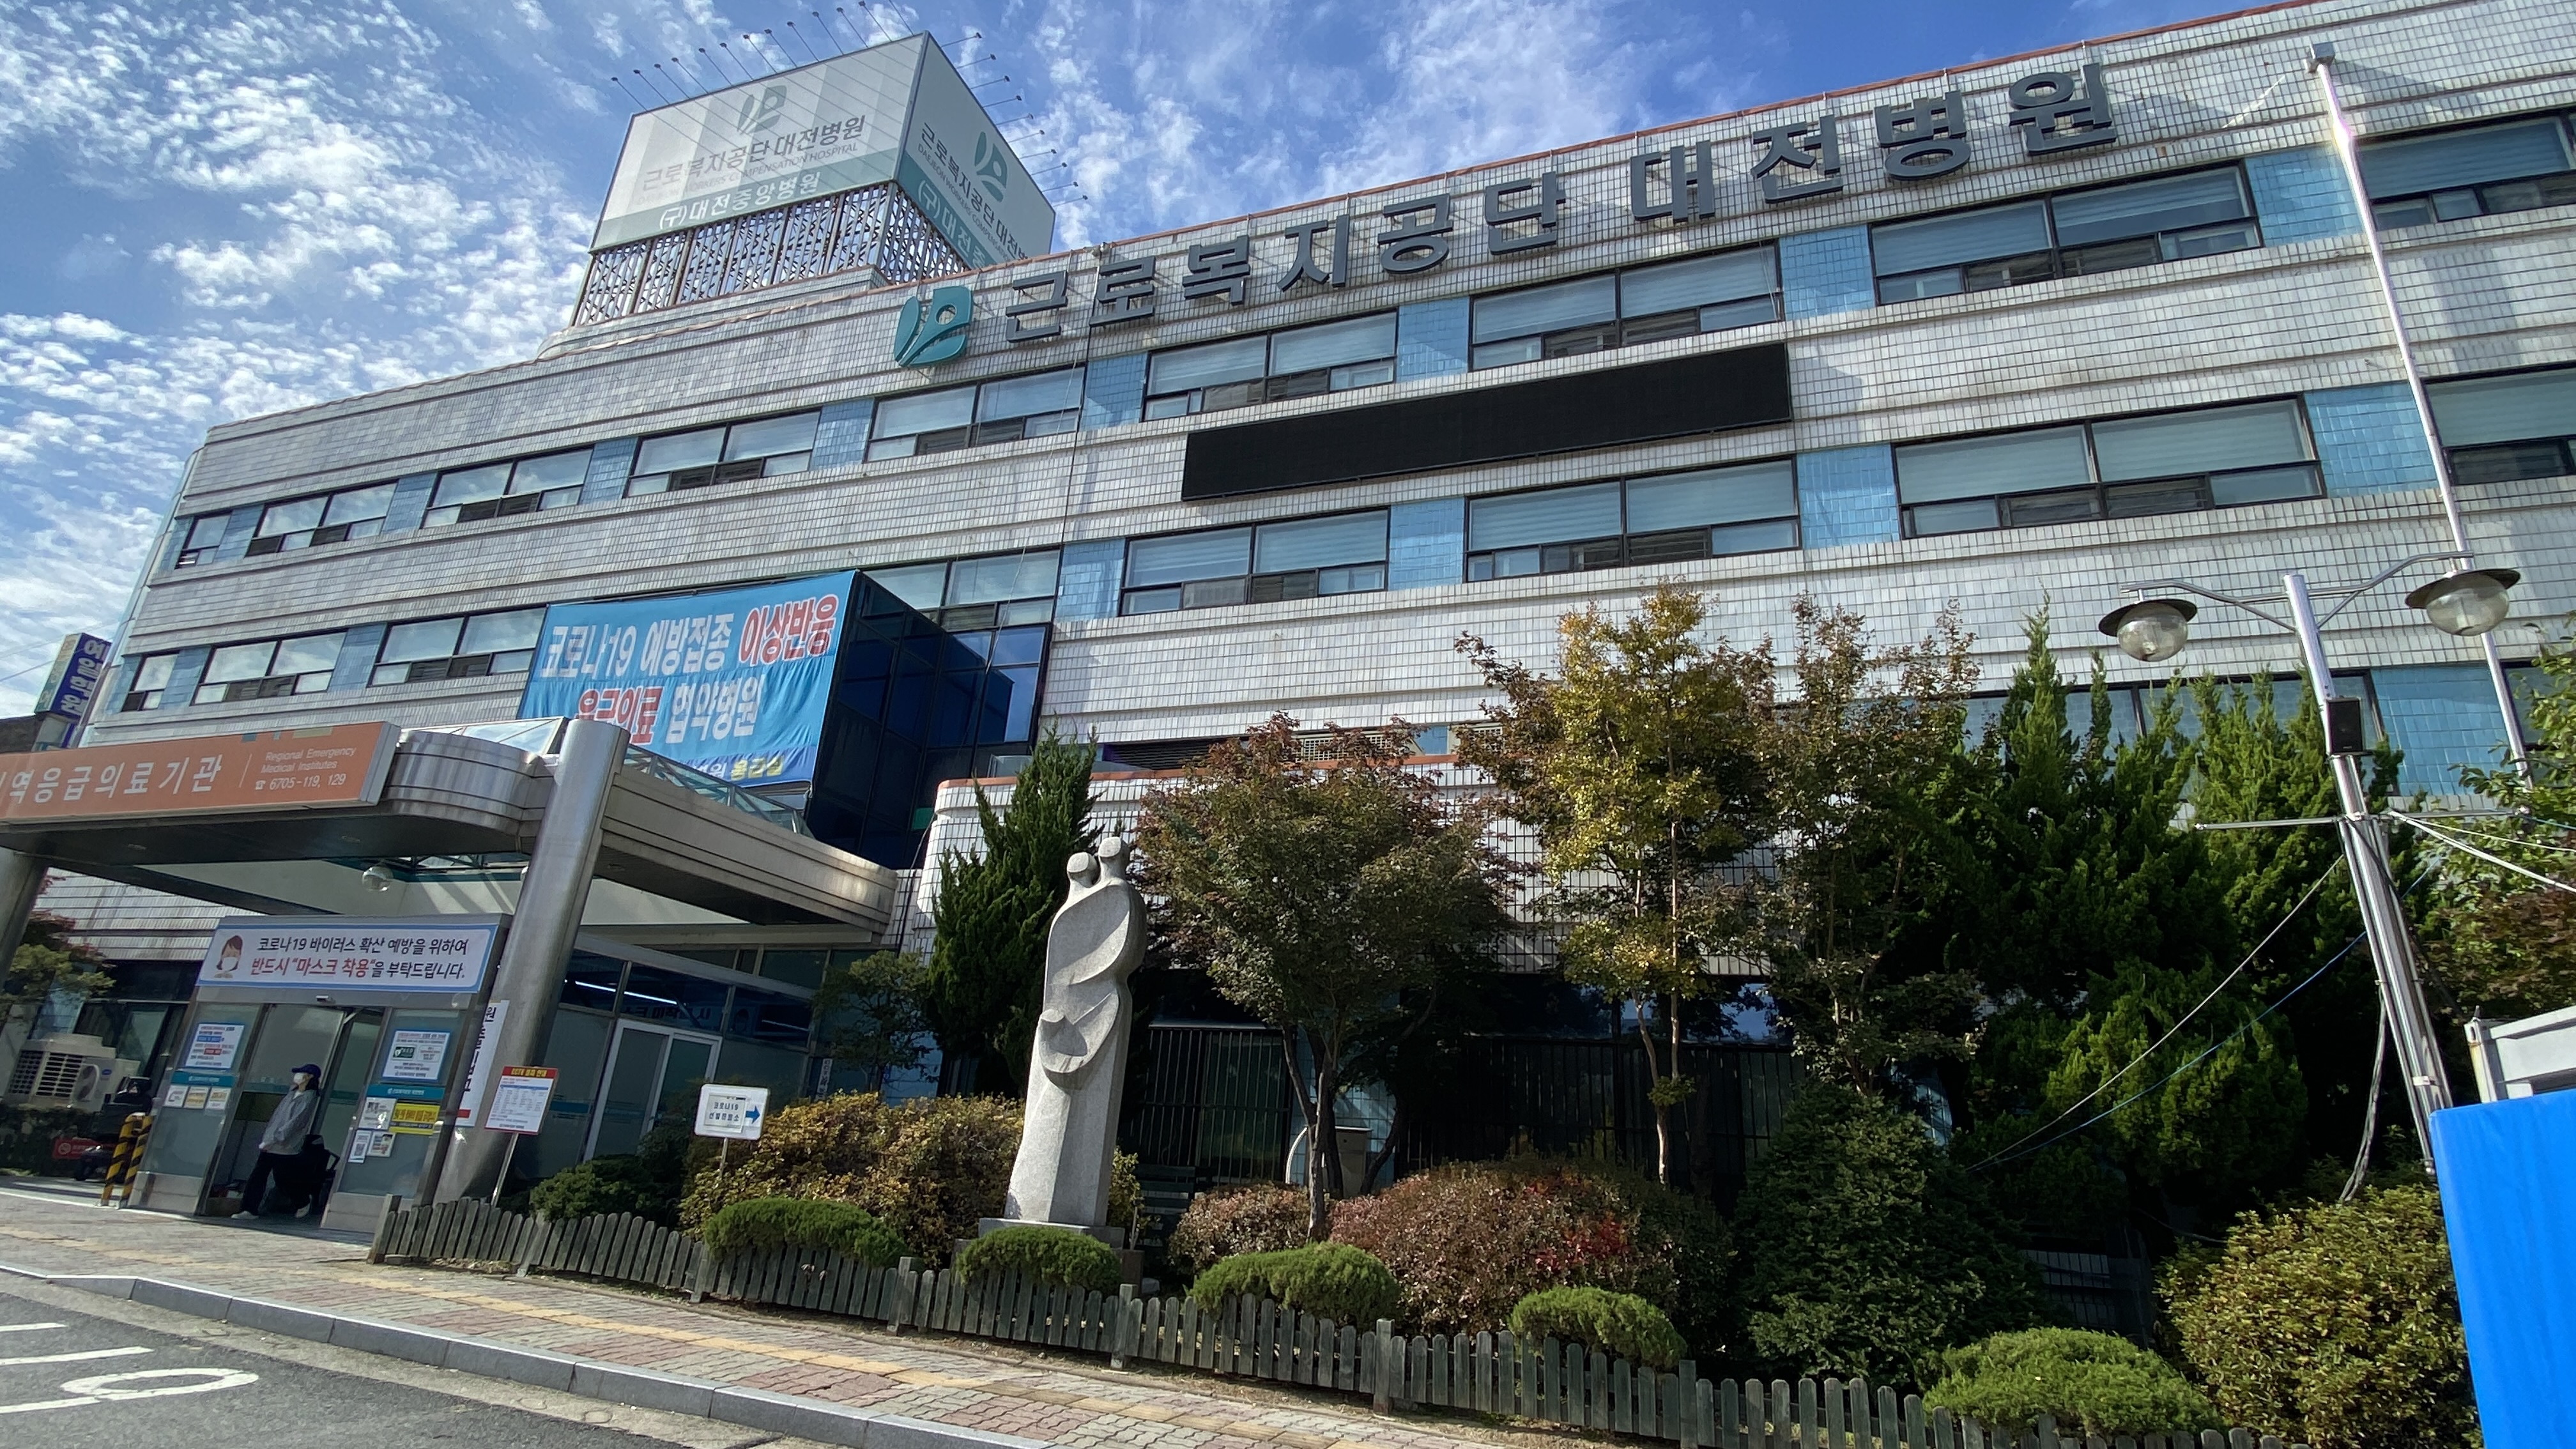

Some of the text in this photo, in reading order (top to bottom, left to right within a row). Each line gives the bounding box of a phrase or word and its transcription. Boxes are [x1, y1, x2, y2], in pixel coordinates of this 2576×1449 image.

[643, 114, 866, 192] 근로복지공단 대전병원
[809, 142, 858, 161] HOSPITAL
[918, 143, 946, 182] DAEJEON
[921, 122, 995, 228] 근로복지공단
[659, 171, 821, 229] (구)대전중앙병원
[1005, 62, 2117, 344] 근로복지공단 대전병원
[541, 594, 839, 680] 코로나19 예방접종 이상반응
[665, 674, 765, 744] 협약병원
[260, 760, 338, 774] Medical Institutes
[266, 747, 356, 762] Regional Emergency
[0, 755, 222, 804] 역응급의료기관
[327, 774, 346, 786] 129
[257, 937, 470, 956] 코로나19 바이러스 확산 예방을 위하여
[386, 962, 466, 979] 부탁드립니다.
